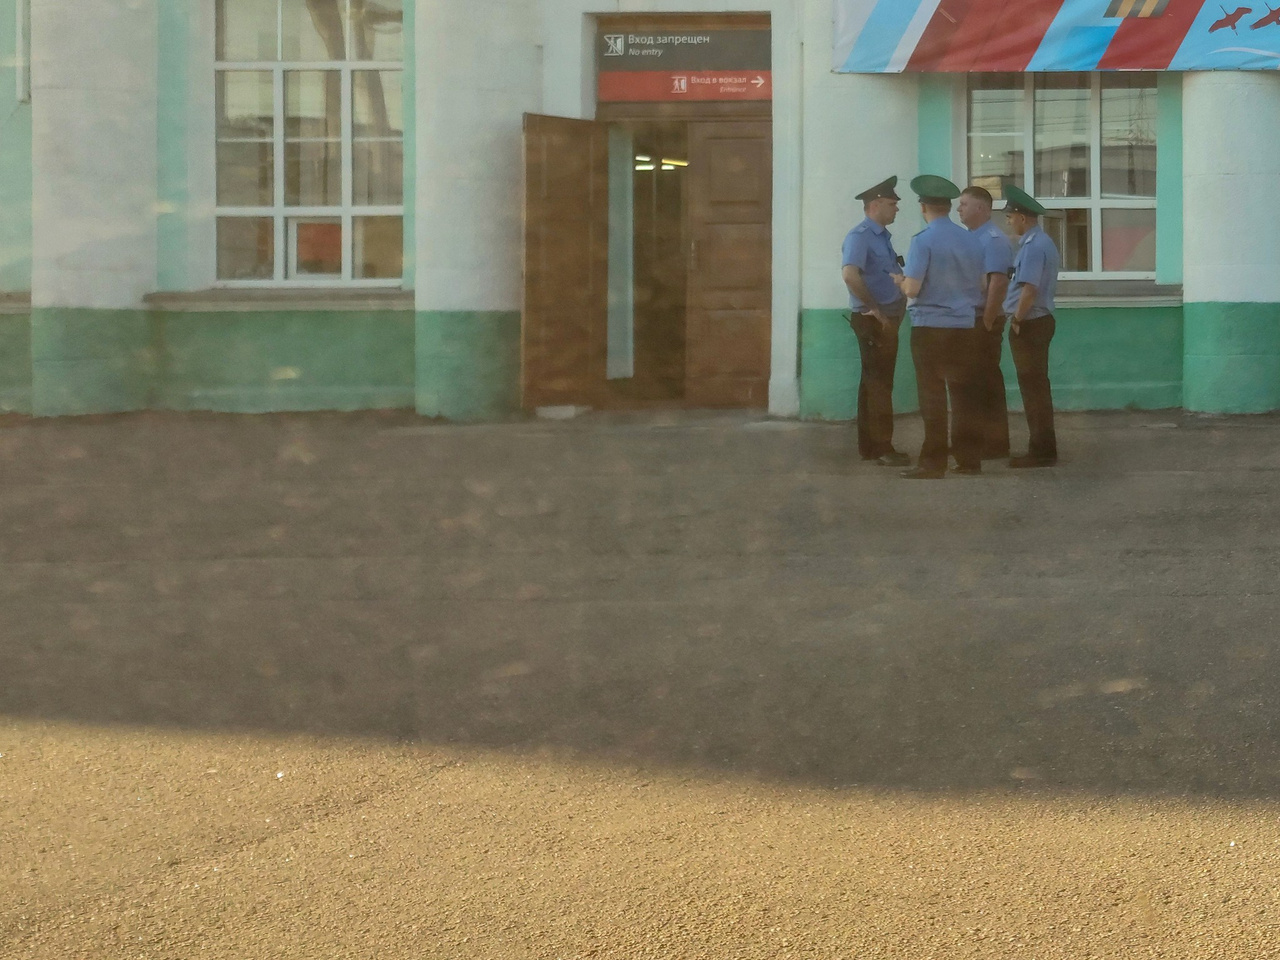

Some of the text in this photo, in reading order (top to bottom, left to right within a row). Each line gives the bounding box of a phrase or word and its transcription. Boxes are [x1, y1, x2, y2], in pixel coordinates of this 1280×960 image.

[628, 34, 710, 46] Вход запрещен
[628, 48, 663, 58] No entry
[691, 76, 711, 84] Вход
